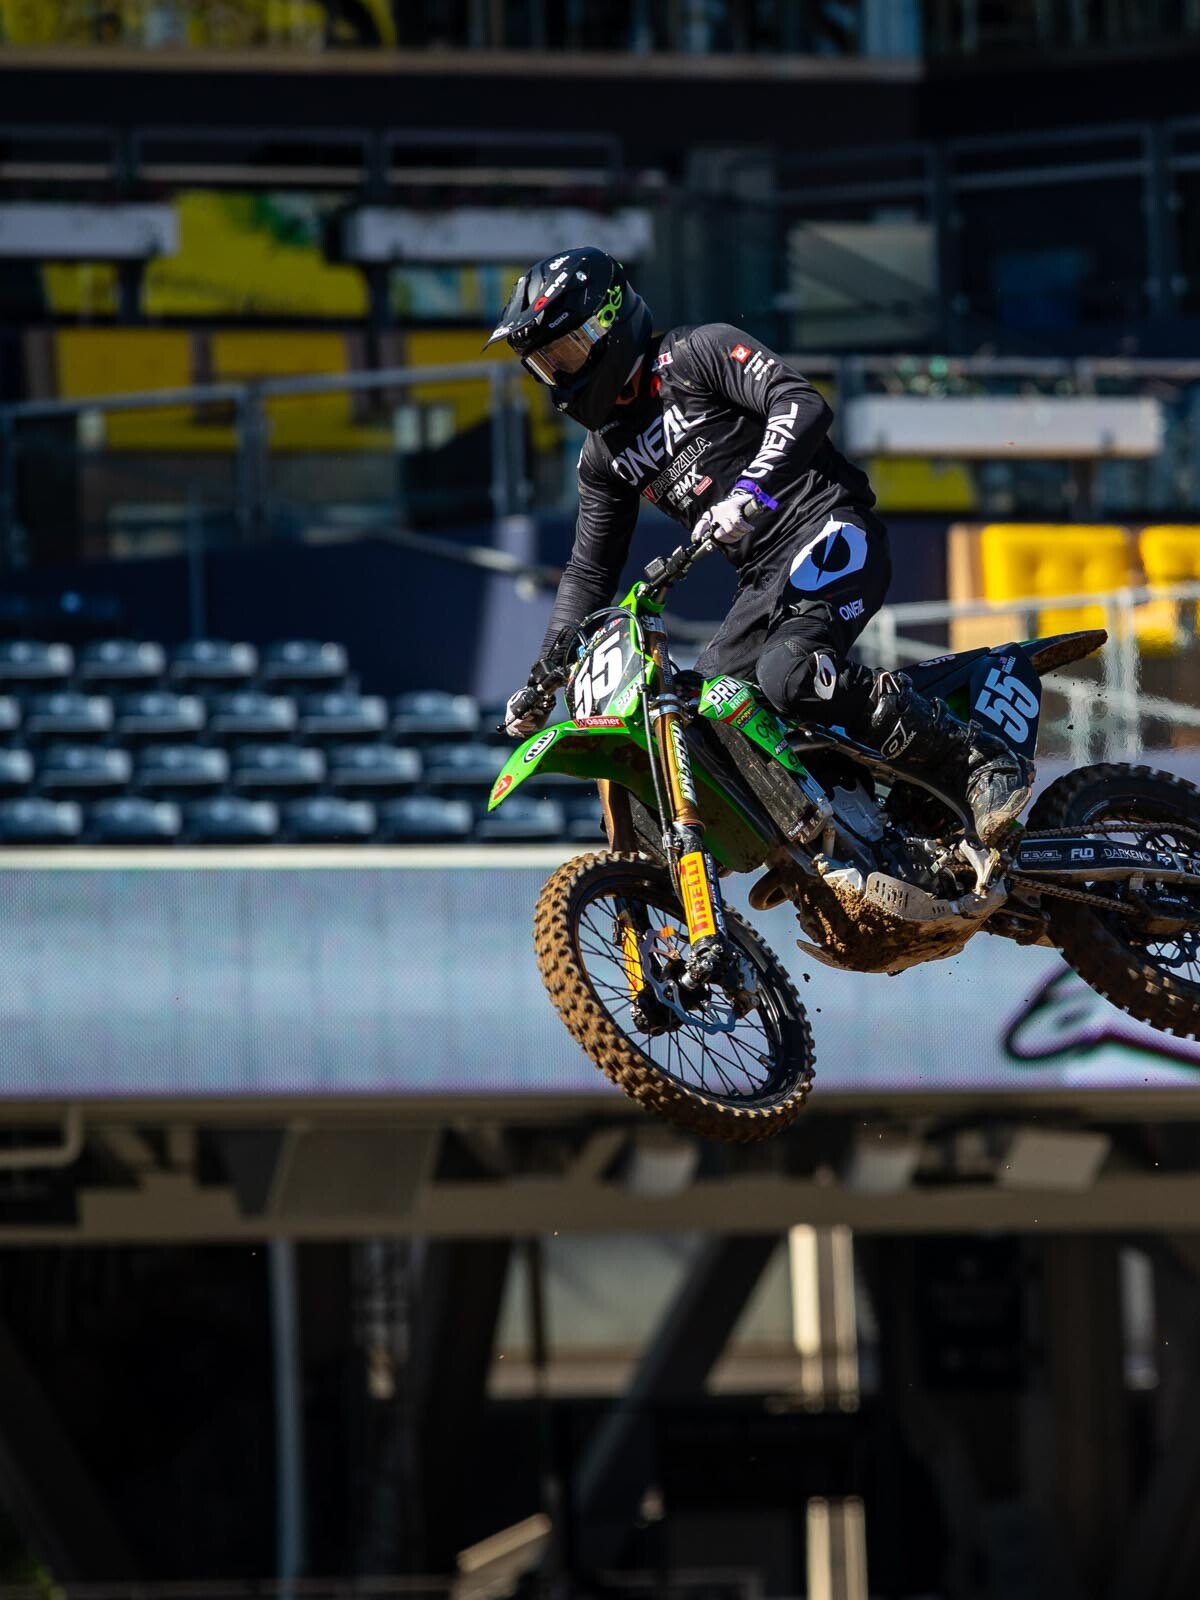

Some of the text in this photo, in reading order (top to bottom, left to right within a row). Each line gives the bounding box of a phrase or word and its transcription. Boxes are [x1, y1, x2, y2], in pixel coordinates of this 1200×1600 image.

[652, 436, 712, 498] PARTZILLA
[666, 460, 704, 506] PRMX
[574, 630, 624, 721] 55
[728, 687, 753, 710] RACIN
[974, 667, 1040, 744] 55
[681, 859, 710, 935] PIRELLI
